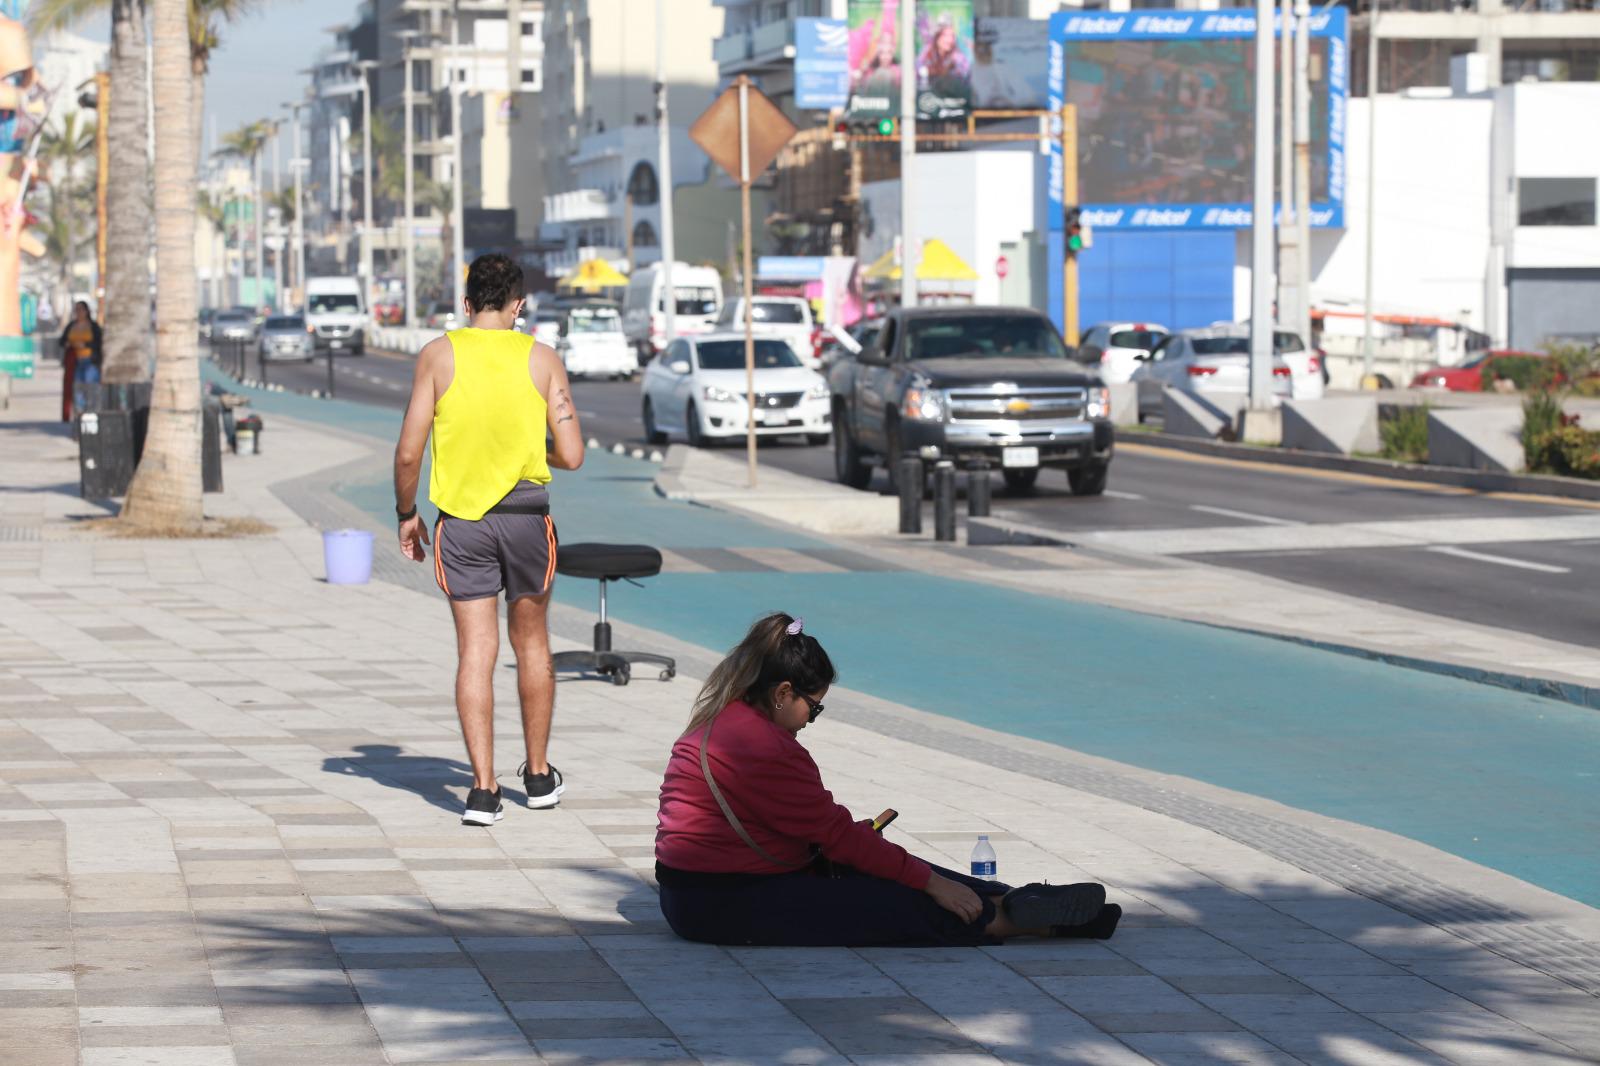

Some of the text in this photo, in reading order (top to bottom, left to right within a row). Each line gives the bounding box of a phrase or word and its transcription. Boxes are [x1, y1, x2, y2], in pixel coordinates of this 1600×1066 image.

[1079, 16, 1125, 34] telcel
[1147, 15, 1193, 34] telcel
[1216, 15, 1257, 32] telce
[1079, 208, 1124, 226] telcel
[1146, 208, 1192, 226] telcel
